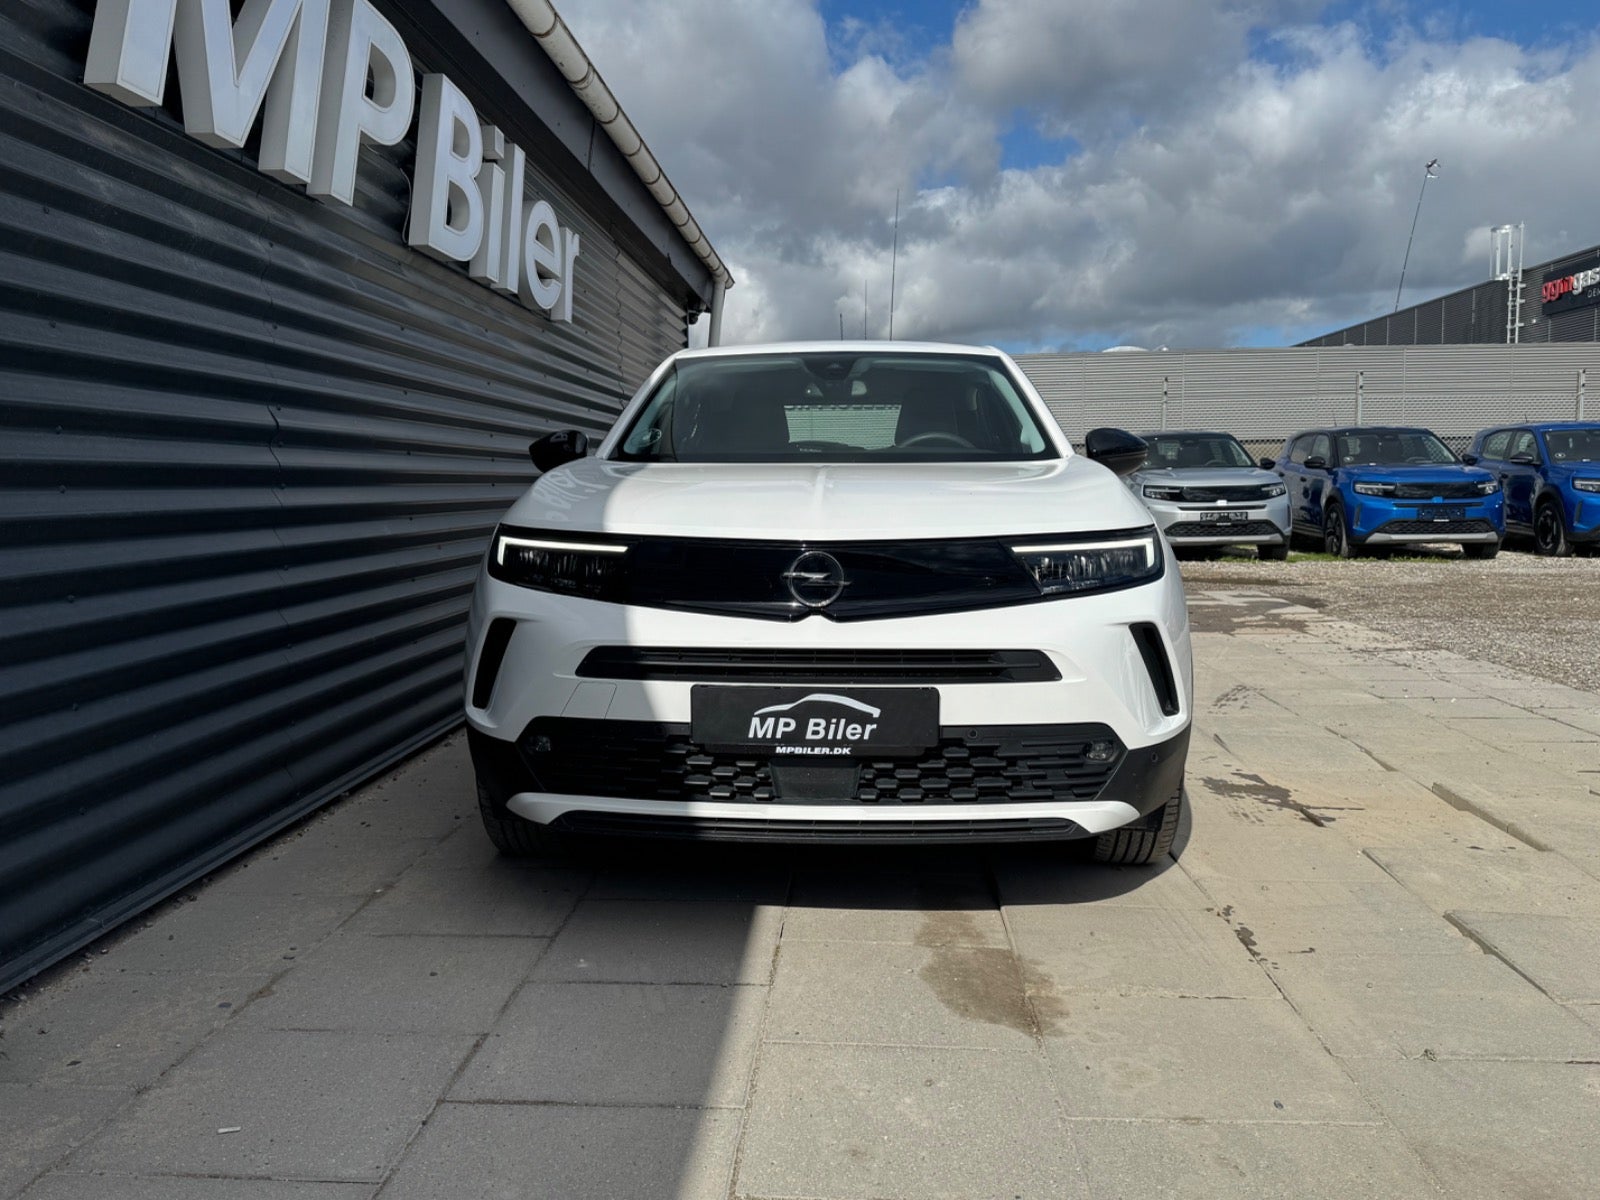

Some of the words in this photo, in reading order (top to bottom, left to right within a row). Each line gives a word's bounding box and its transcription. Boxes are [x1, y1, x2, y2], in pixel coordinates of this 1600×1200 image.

[408, 73, 580, 324] Biler
[748, 716, 797, 739] MP
[805, 718, 877, 740] Biler
[775, 746, 852, 755] MPBILER.DK
